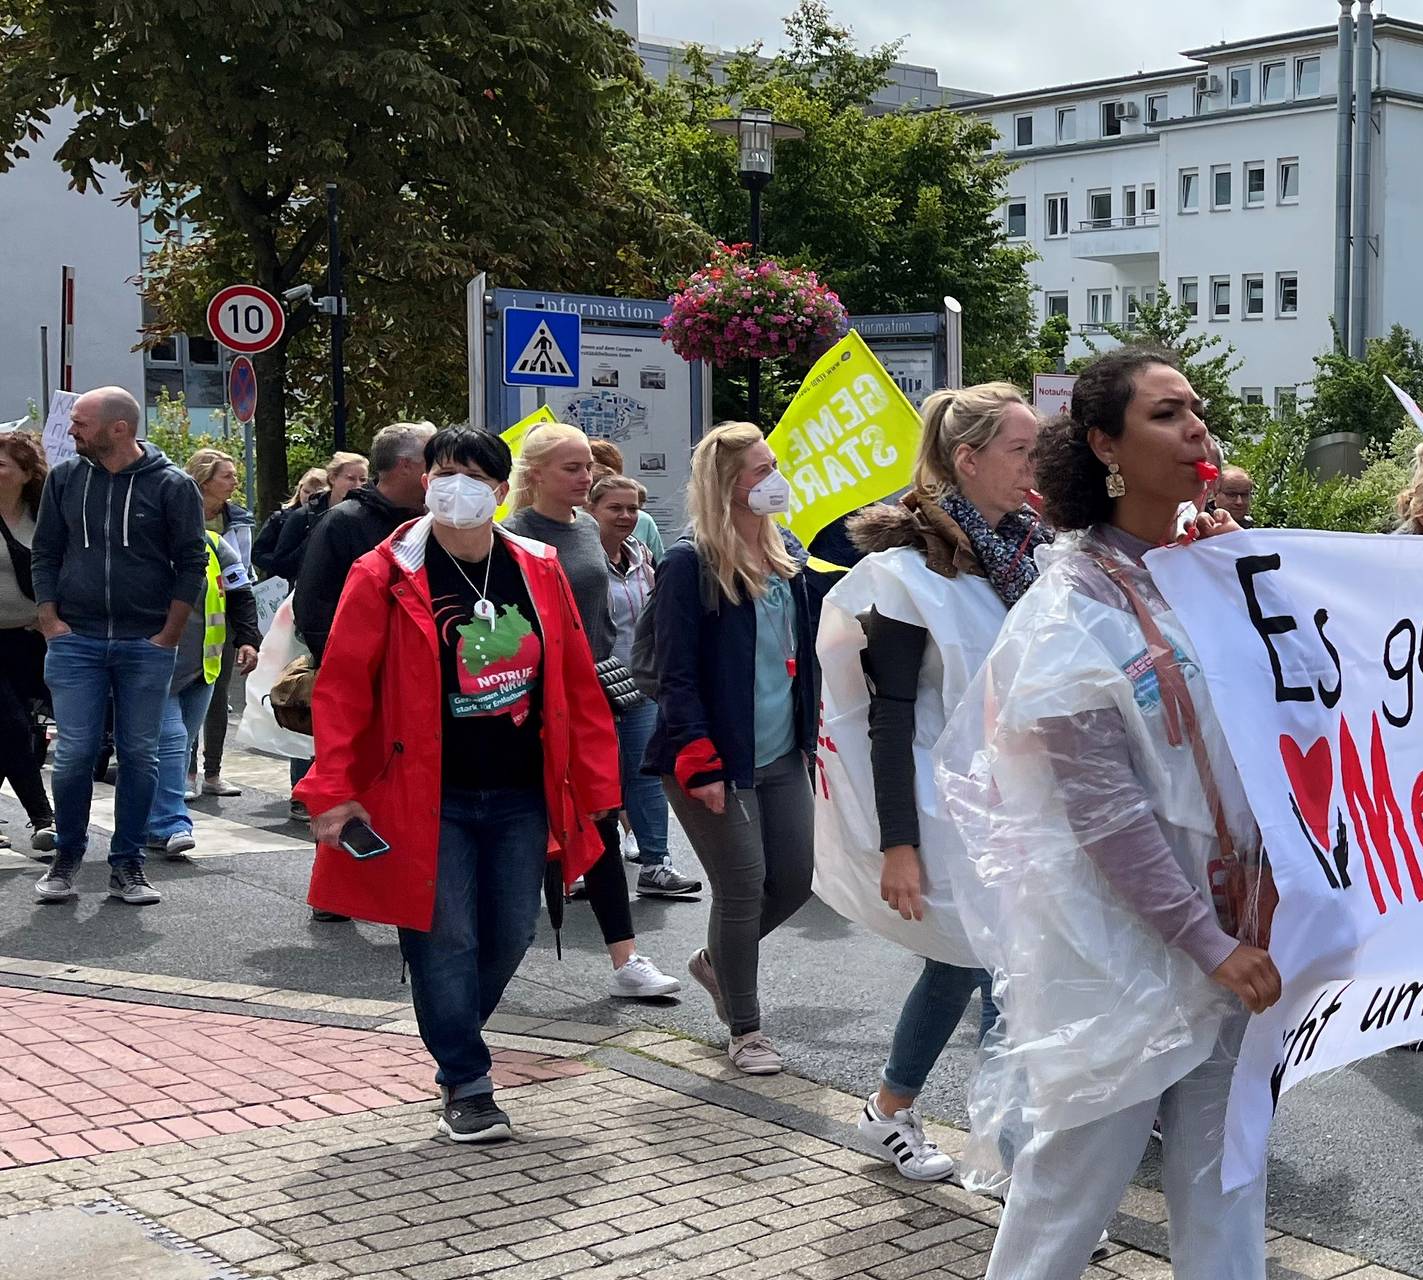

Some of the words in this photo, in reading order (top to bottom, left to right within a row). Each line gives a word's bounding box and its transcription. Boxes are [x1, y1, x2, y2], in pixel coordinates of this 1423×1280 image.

[228, 304, 263, 334] 10
[1039, 387, 1073, 396] Notaufna
[1236, 553, 1342, 709] Es
